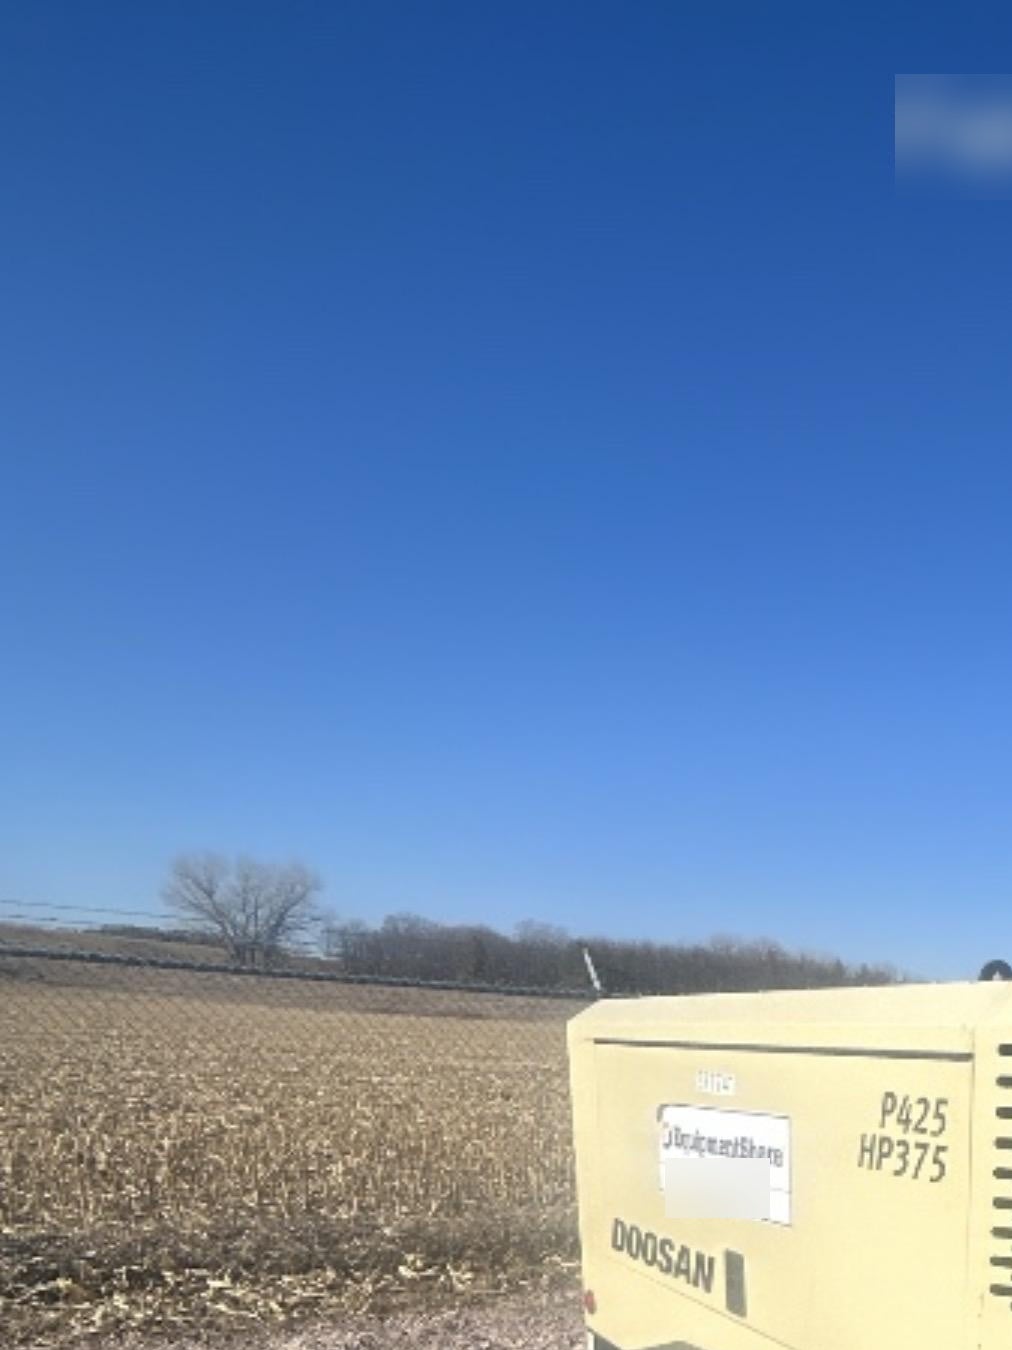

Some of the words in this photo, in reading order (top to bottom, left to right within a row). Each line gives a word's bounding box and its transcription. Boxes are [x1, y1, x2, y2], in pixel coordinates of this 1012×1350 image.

[879, 1091, 948, 1136] P425
[857, 1133, 949, 1183] HP375
[611, 1217, 715, 1293] DOOSAN
